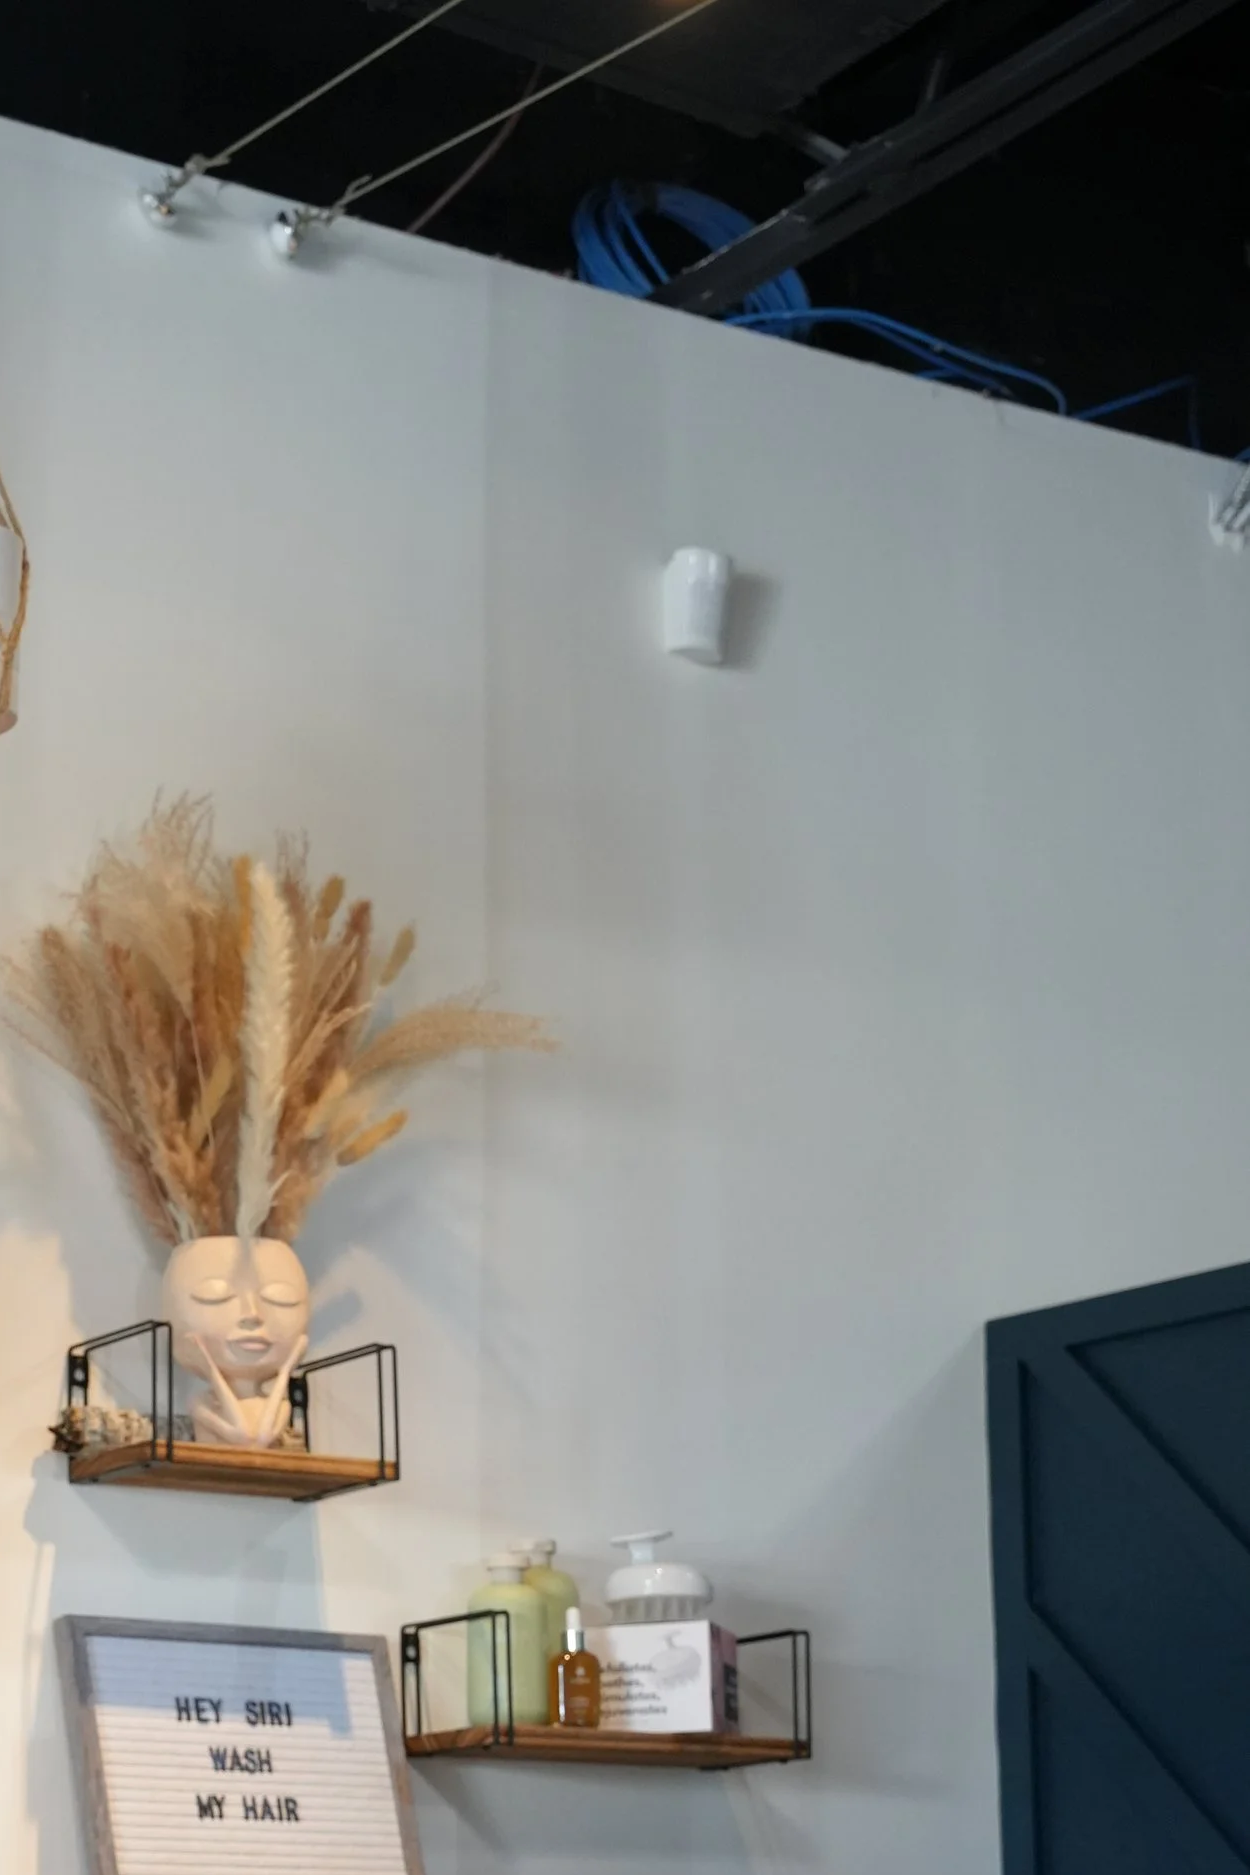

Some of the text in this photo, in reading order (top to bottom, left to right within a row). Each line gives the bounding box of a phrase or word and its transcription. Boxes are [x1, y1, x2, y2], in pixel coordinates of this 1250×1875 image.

[174, 1696, 293, 1727] HEY SIRI
[208, 1746, 273, 1774] WASH
[196, 1793, 300, 1822] MY HAIR
